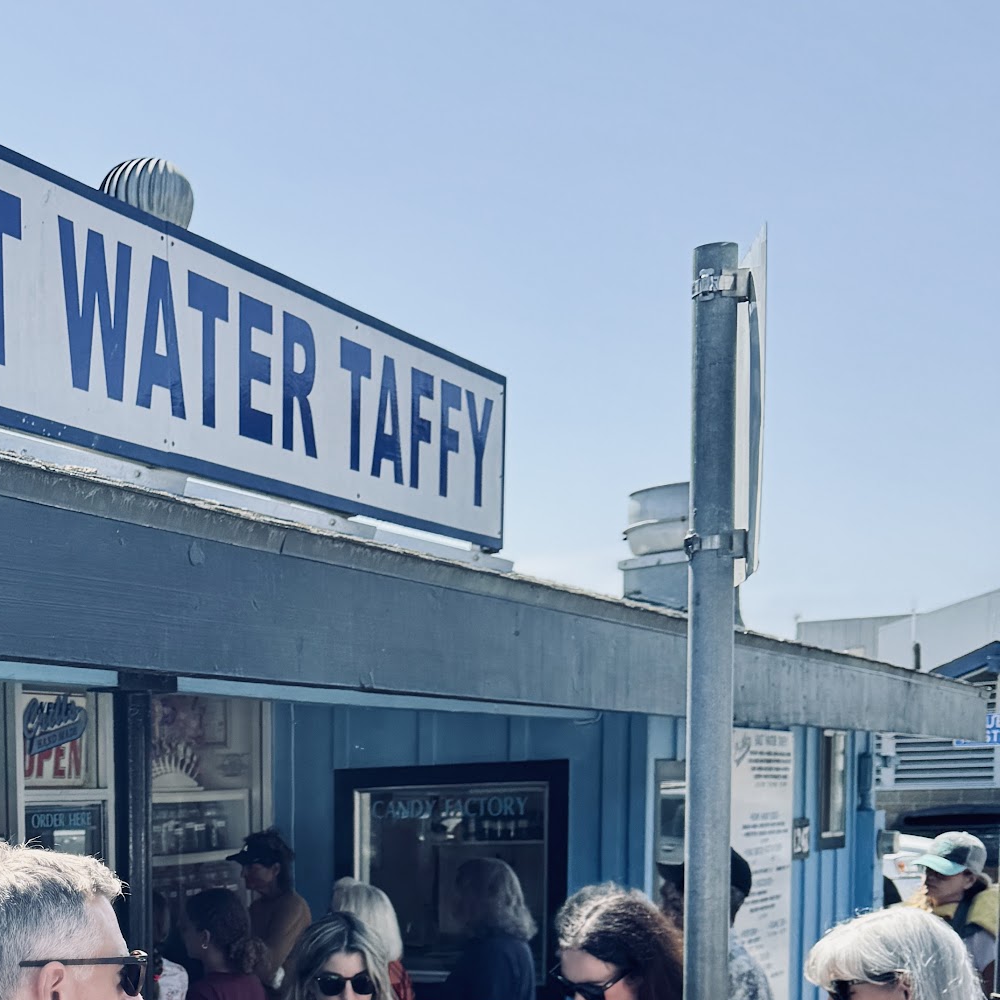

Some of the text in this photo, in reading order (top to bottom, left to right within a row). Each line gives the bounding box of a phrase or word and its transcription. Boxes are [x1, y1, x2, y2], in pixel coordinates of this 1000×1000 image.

[57, 215, 318, 459] WATER
[340, 336, 494, 507] TAFFY
[31, 811, 92, 829] ORDER HERE
[372, 796, 528, 820] CANDY FACTORY
